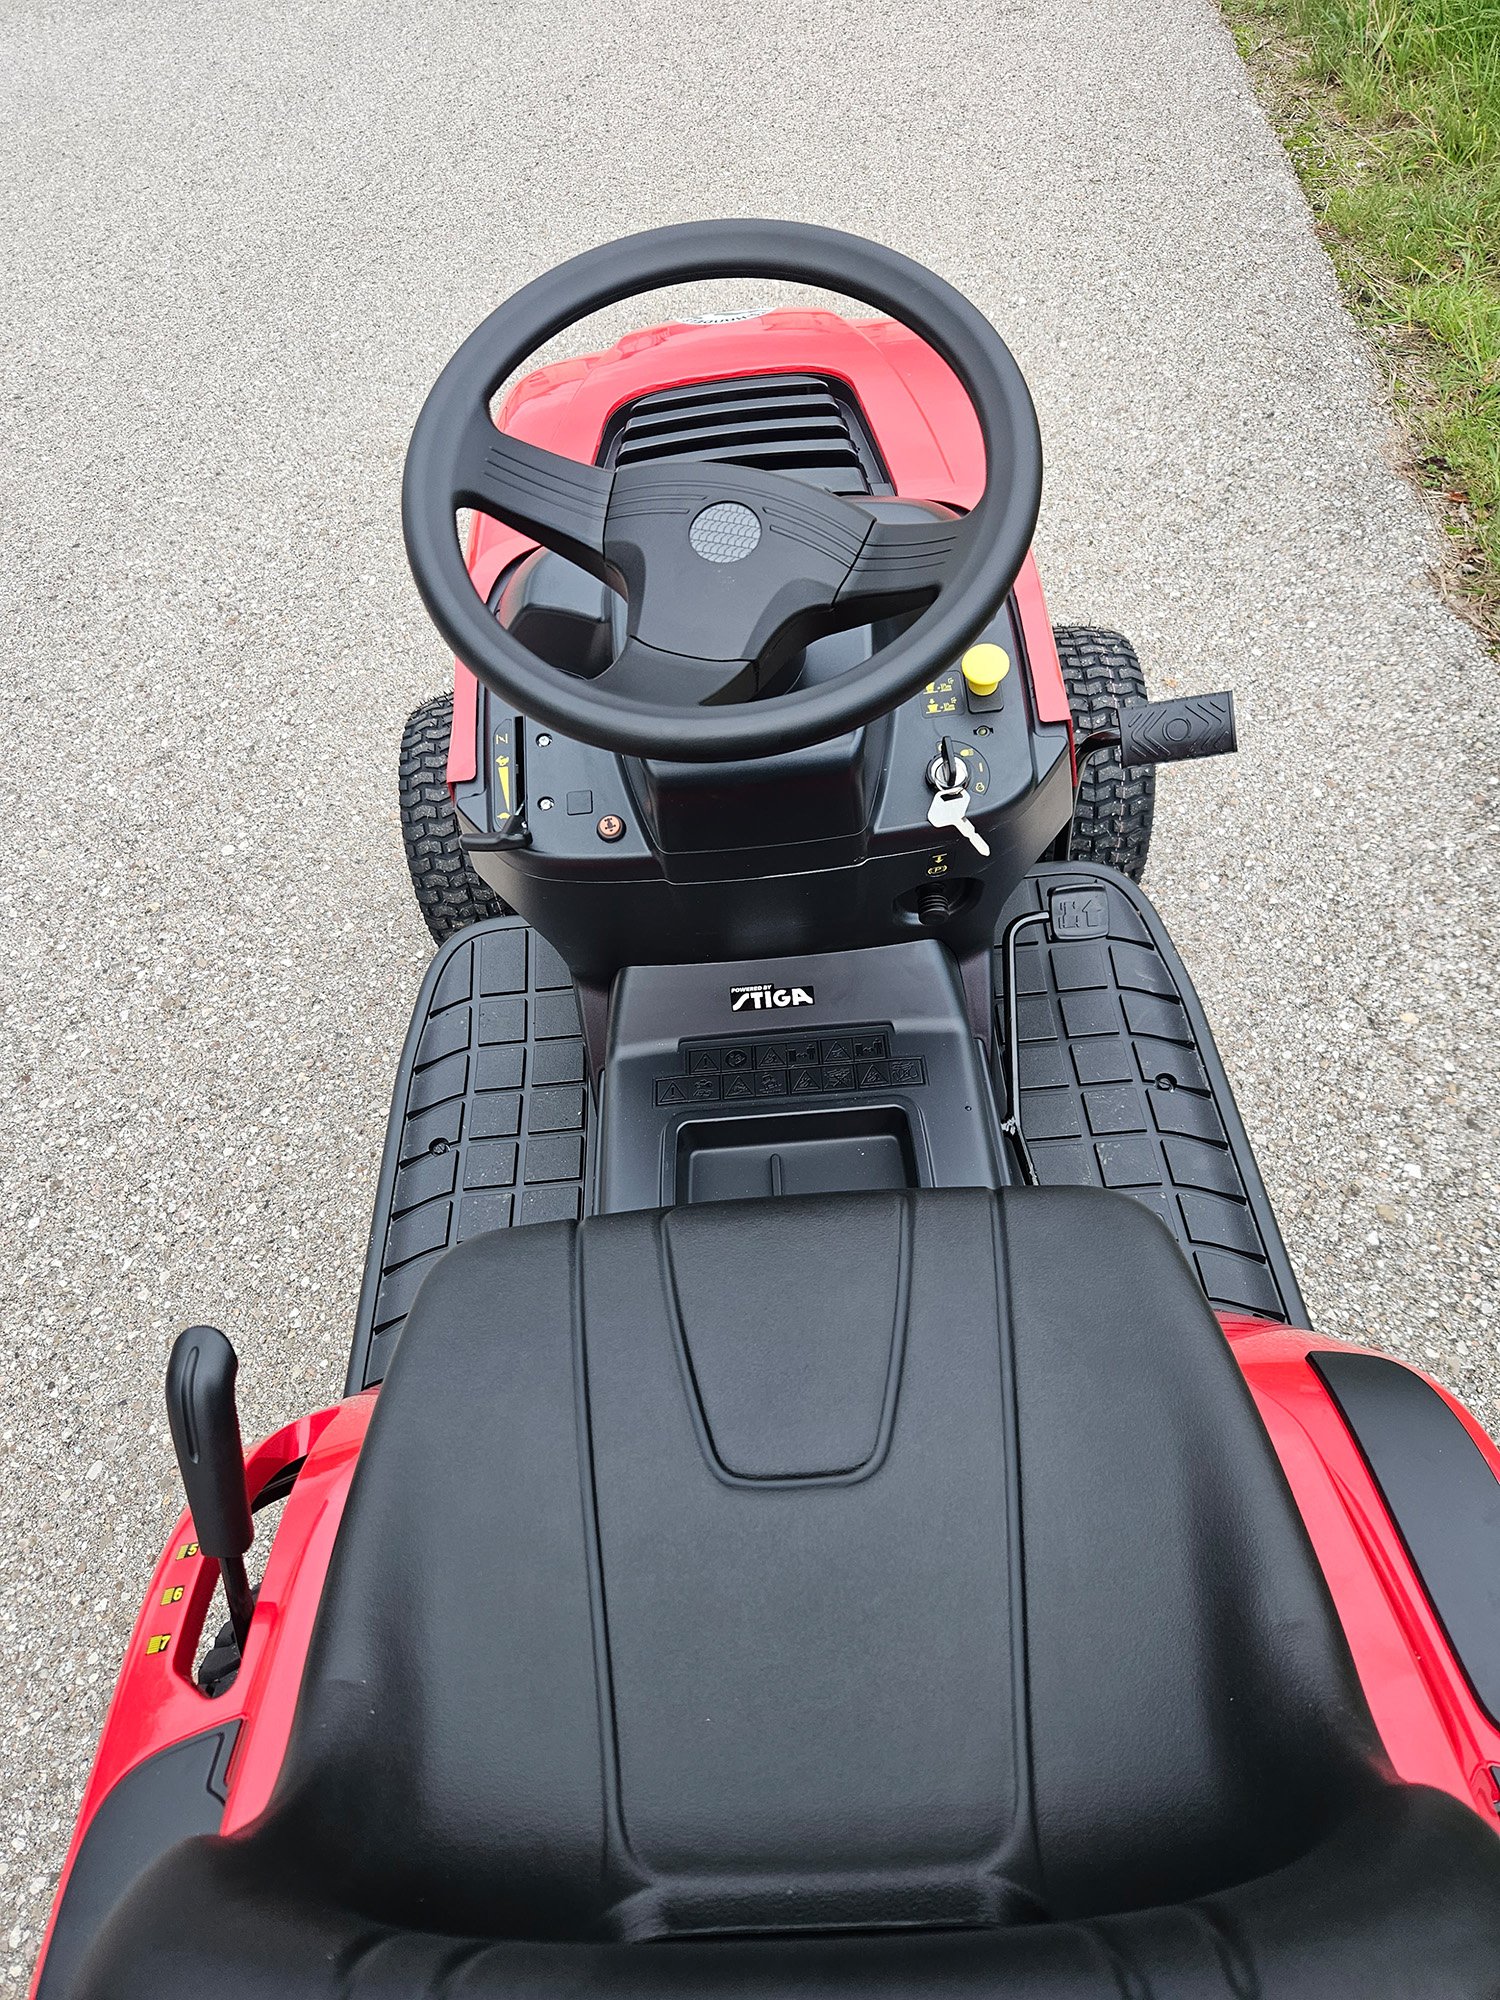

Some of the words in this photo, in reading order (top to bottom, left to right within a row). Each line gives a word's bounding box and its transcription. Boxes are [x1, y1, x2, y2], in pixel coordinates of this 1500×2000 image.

[732, 988, 814, 1011] STIGA
[187, 1543, 199, 1556] 5
[172, 1587, 184, 1600] 6
[160, 1635, 171, 1650] 7
